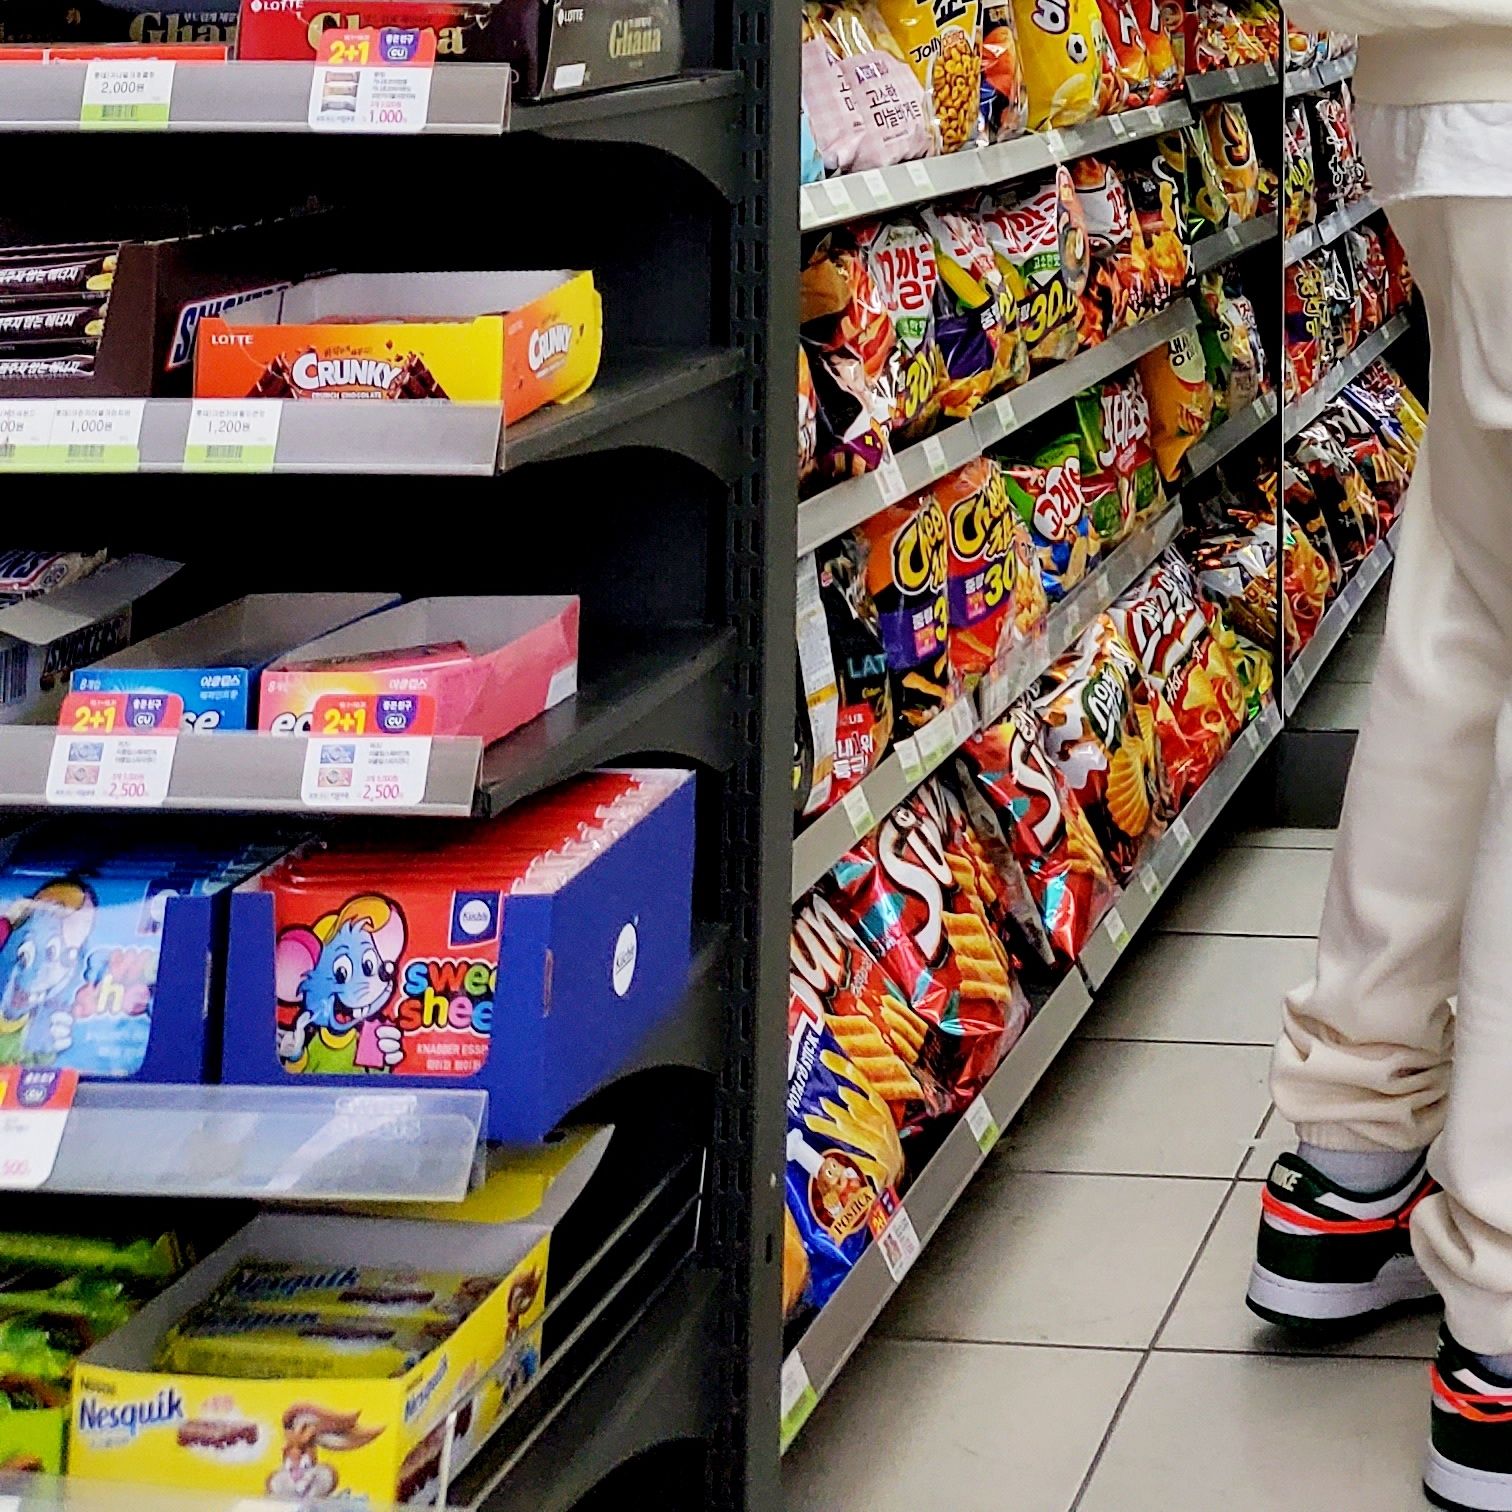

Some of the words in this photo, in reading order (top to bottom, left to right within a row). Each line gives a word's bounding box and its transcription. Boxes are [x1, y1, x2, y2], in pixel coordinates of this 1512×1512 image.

[264, 0, 305, 11] LOTTE
[564, 9, 583, 22] LOTTE
[609, 17, 661, 58] Ghana
[329, 41, 369, 64] 2+1
[101, 82, 144, 93] 2,000원
[212, 335, 253, 344] LOTTE
[529, 324, 572, 370] CRUNKY
[292, 353, 401, 389] CRUNKY
[71, 420, 112, 432] 1,000원
[208, 421, 249, 432] 1,200원
[73, 705, 114, 732] 2+1
[136, 715, 152, 727] CU
[323, 706, 366, 734] 2+1
[387, 715, 403, 728] CU
[79, 1388, 185, 1439] Nesquik
